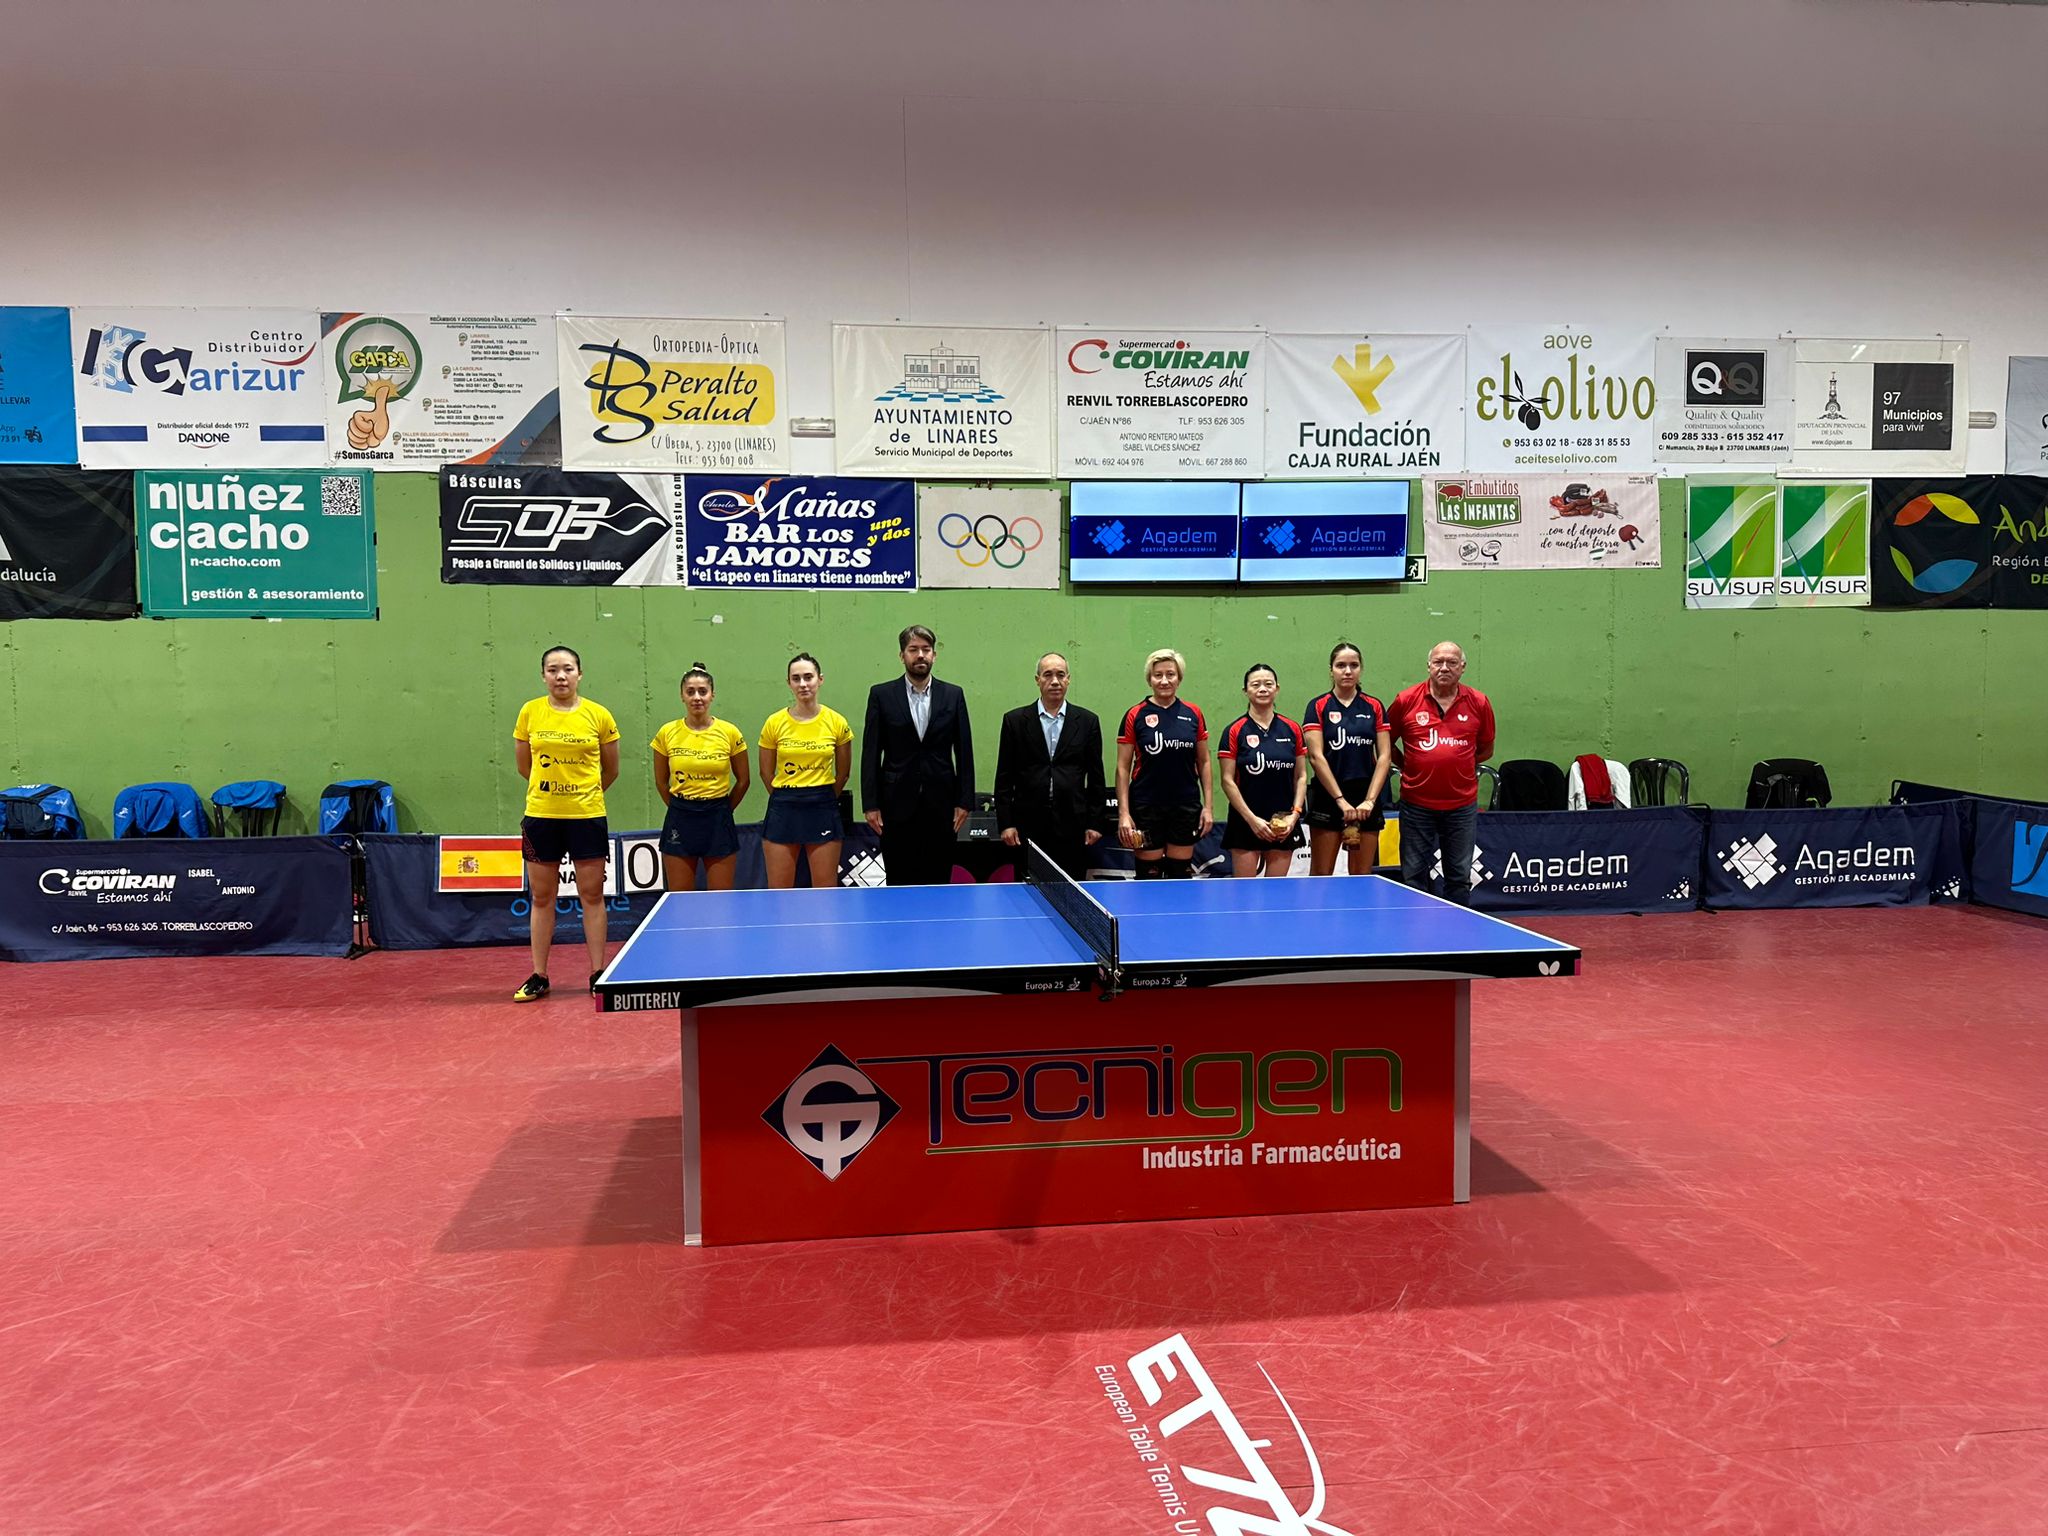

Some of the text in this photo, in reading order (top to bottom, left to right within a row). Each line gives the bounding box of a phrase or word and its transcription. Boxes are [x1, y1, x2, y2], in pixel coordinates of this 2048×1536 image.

[250, 330, 303, 341] Centro
[1543, 334, 1593, 349] aove
[208, 342, 305, 353] Distribuidor
[1118, 339, 1191, 350] Supermercados
[349, 350, 410, 368] GARCA
[1112, 351, 1250, 369] COVIRAN
[661, 366, 757, 395] Peralto
[1144, 370, 1247, 389] Estamos ahí
[0, 396, 31, 405] LLEVAR
[1067, 395, 1248, 407] RENVIL TORREBLASCOPEDRO
[1883, 391, 1901, 405] 97
[662, 396, 758, 423] Salud
[874, 408, 1012, 425] AYUNTAMIENTO
[1685, 409, 1765, 421] Quality Quality
[1883, 409, 1943, 423] Municipios
[1080, 416, 1111, 426] C/JAÉN
[1178, 417, 1245, 426] TLF: 953 626 305
[1882, 423, 1925, 433] para vivir
[178, 433, 230, 443] DANONE
[889, 428, 998, 444] de LINARES
[1119, 433, 1204, 441] ANTONIO RENTERO MATEOS
[1299, 420, 1431, 447] Fundación
[1661, 432, 1784, 441] 609 285 333 615 352 417
[707, 437, 776, 452] 23700 (LINARES)
[1122, 443, 1144, 451] ISABEL
[1145, 443, 1171, 451] VILCHES
[1514, 438, 1631, 447] 953 63 02 18 628 31 85 53
[334, 450, 394, 460] #SomosGarca
[874, 446, 1013, 459] Servicio Municipal de Deportes
[1288, 448, 1440, 468] CAJA RURAL JAÉN
[1514, 453, 1618, 464] aceiteselolivo.com
[701, 454, 754, 468] 953 607 008
[1101, 458, 1116, 466] 692
[1117, 458, 1132, 466] 404
[1132, 458, 1144, 466] 976
[1205, 457, 1220, 466] 667
[1220, 457, 1233, 466] 288
[449, 474, 522, 489] Básculas
[1468, 479, 1519, 496] Embutidos
[149, 474, 305, 511] nuñez
[754, 484, 877, 522] Mañas
[1439, 501, 1516, 521] LAS INFANTAS
[869, 517, 902, 532] uno
[1567, 523, 1617, 539] el deporte
[149, 514, 309, 550] cacho
[724, 522, 854, 544] BAR LOS
[867, 526, 911, 547] y dos
[1141, 526, 1217, 547] Aqadem
[1311, 525, 1386, 546] Aqadem
[1540, 537, 1620, 550] de nuestra tierra
[190, 555, 281, 568] n-cacho.com
[695, 545, 872, 568] JAMONES
[1992, 555, 2040, 569] Región
[452, 558, 624, 571] Pesaje Granel de Solidos Liquidos.
[714, 569, 852, 585] tapeo en linares tiene
[1687, 578, 1775, 596] SUVISUR
[1780, 576, 1867, 595] SUVISUR
[191, 588, 365, 602] gestión & asesoramiento
[1164, 738, 1194, 751] Wijnen
[1347, 735, 1373, 747] Wijnen
[1438, 736, 1468, 747] Wijnen
[1266, 760, 1294, 771] Wijnen
[551, 780, 578, 793] Jaén
[1794, 841, 1915, 875] Aqadem
[188, 869, 215, 878] ISABEL
[1503, 850, 1629, 883] Aqadem
[71, 874, 177, 890] COVIRAN
[1794, 872, 1916, 885] GESTIÓN DE ACADEMIAS
[222, 886, 255, 896] ANTONIO
[1502, 880, 1629, 893] GESTIÓN DE ACADEMIAS
[96, 891, 172, 904] Estamos ahí
[106, 922, 158, 932] 953 626 305
[1025, 980, 1065, 992] Europa 25
[1132, 976, 1172, 988] Europa 25
[613, 992, 681, 1011] BUTTERFLY
[920, 1044, 1404, 1148] Tecnigen
[1142, 1138, 1402, 1170] Industria Farmacéutica
[1094, 1364, 1138, 1424] European
[1127, 1424, 1158, 1464] Table
[1147, 1463, 1187, 1518] Tennis
